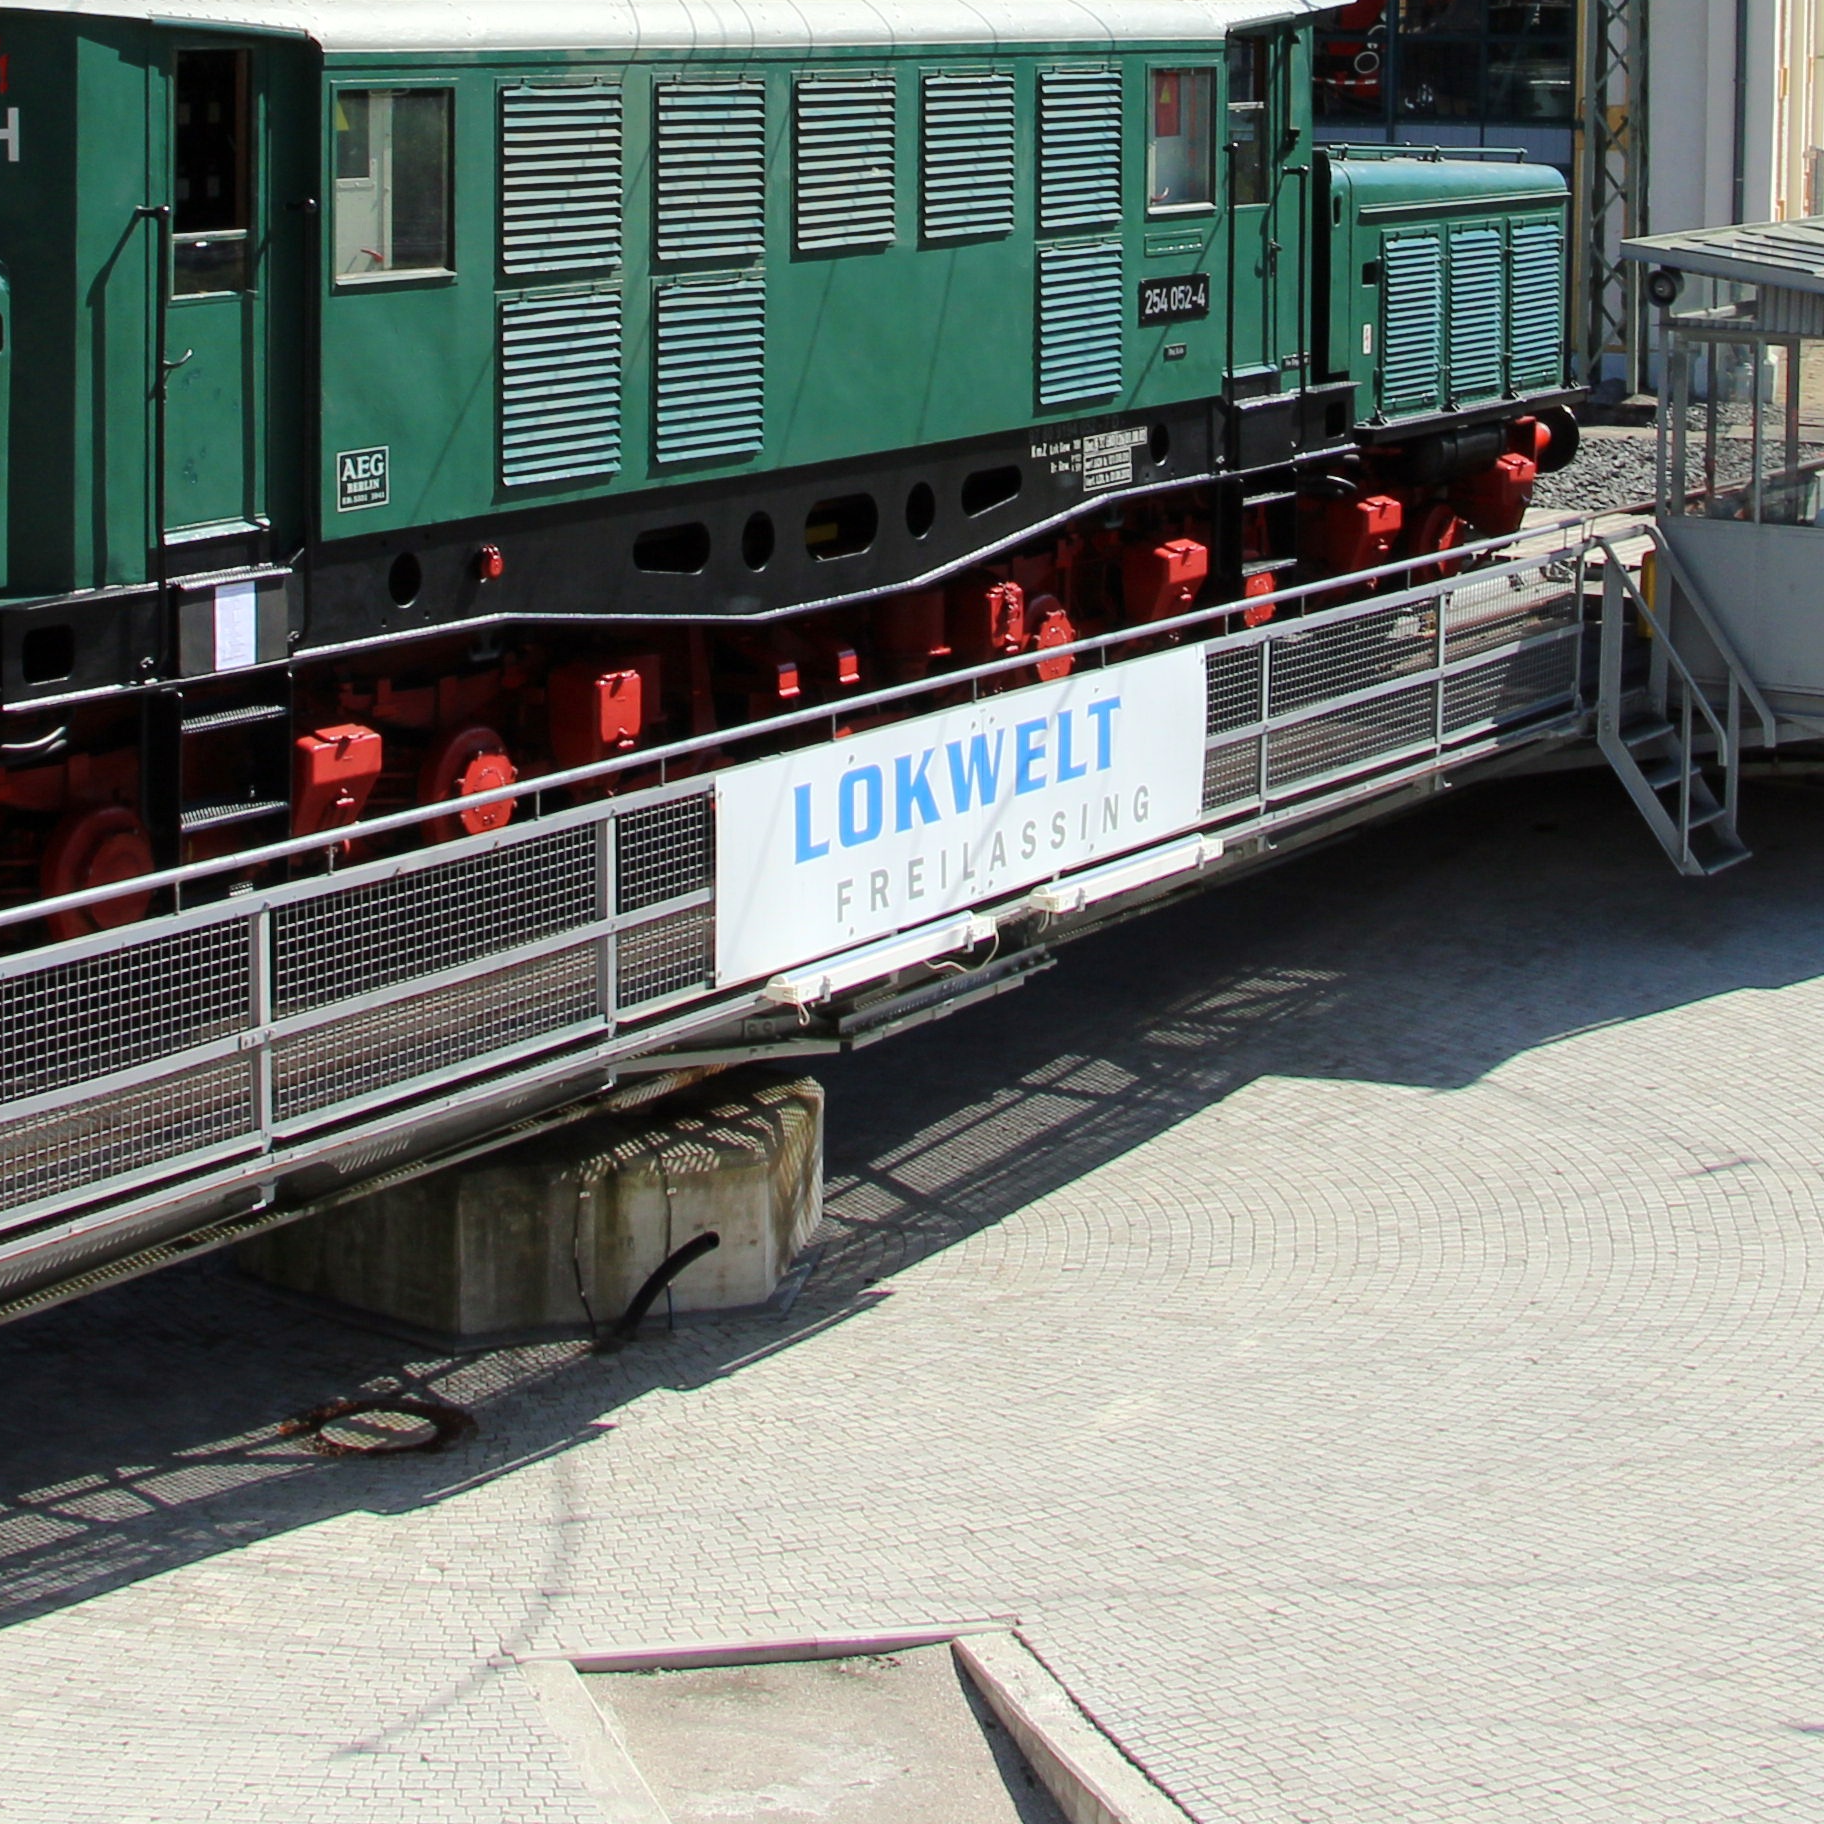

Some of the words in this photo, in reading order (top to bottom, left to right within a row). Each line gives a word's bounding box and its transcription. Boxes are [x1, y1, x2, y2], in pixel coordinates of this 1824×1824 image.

[1144, 287, 1168, 314] 254
[1170, 283, 1205, 311] 052-4
[341, 453, 385, 481] AEG
[346, 478, 380, 494] BERLIN
[794, 696, 1122, 865] LOKWELT
[837, 785, 1151, 923] FREILASSING
